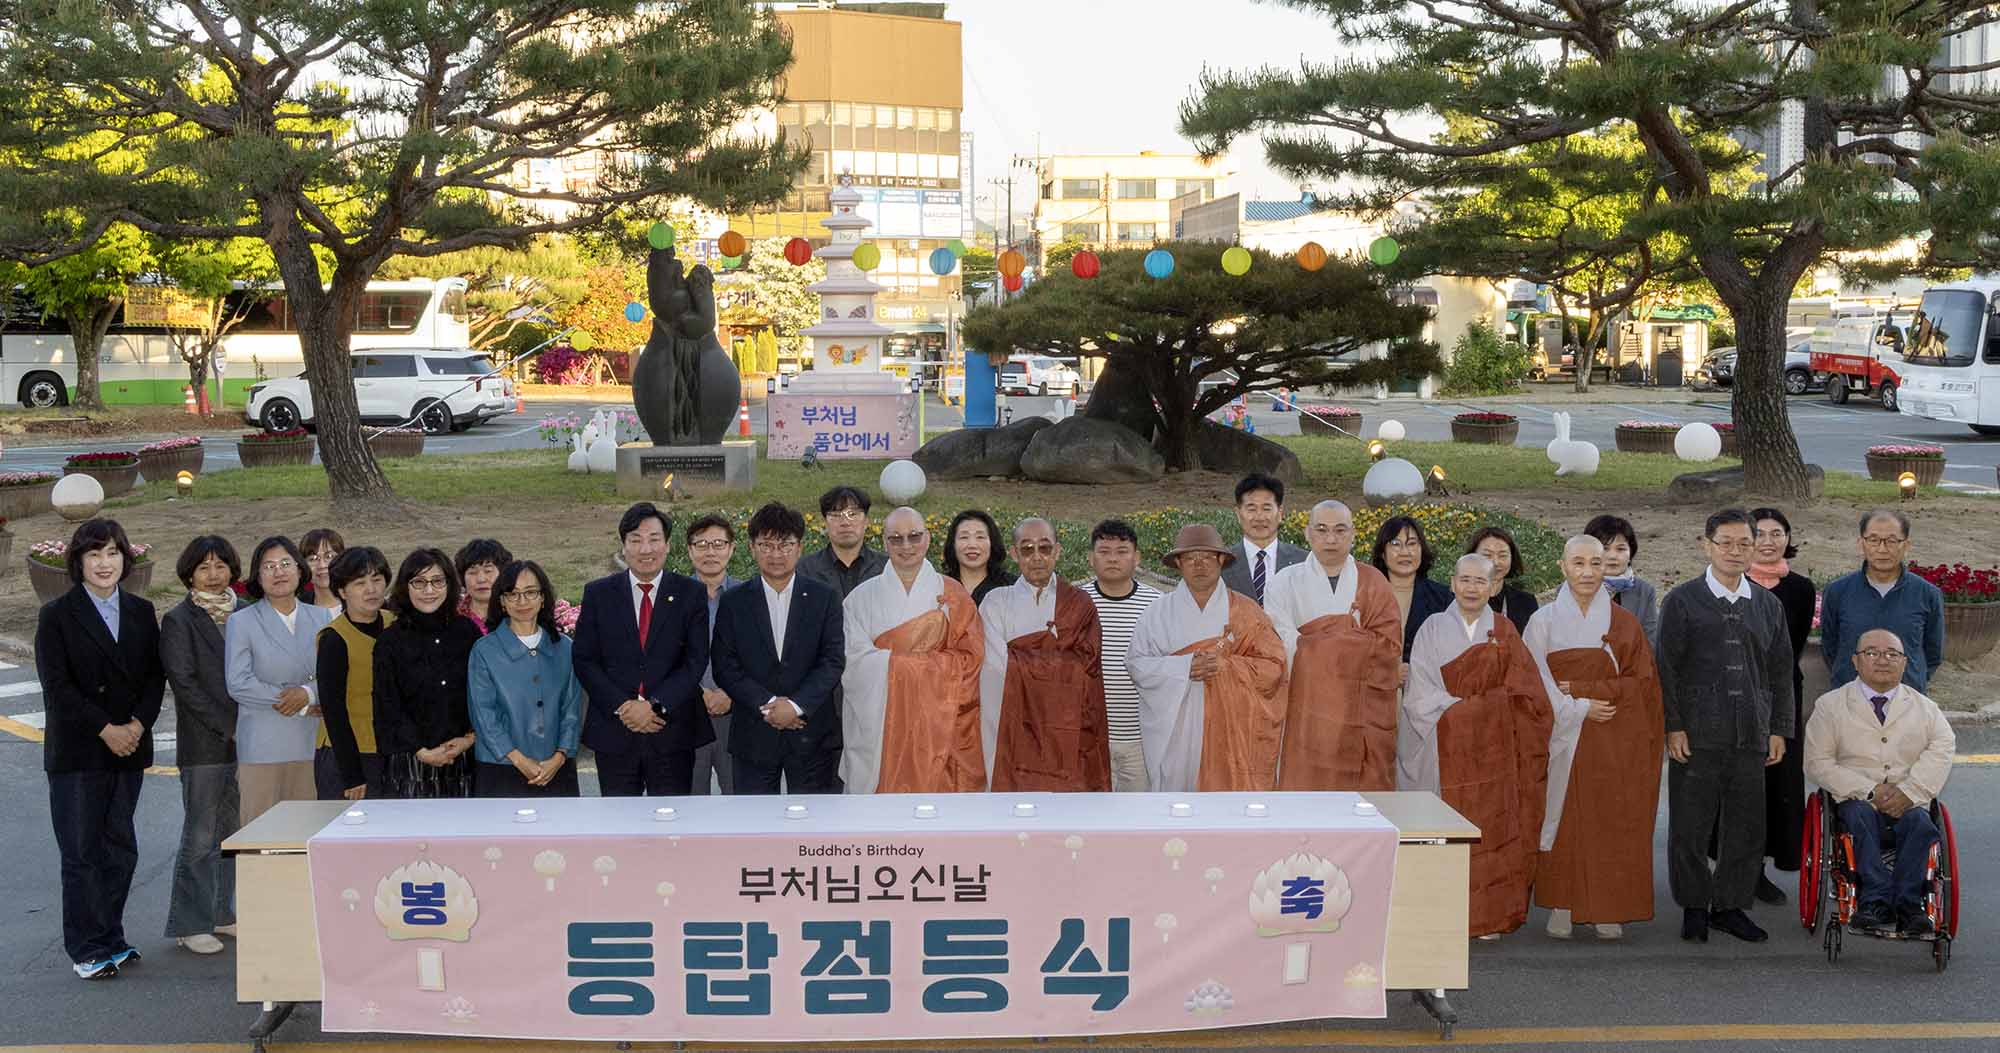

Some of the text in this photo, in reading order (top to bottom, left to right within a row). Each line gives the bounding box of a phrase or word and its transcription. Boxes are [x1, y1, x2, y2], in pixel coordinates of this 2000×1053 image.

[801, 406, 856, 426] 부처님
[813, 432, 890, 452] 품안에서
[799, 845, 924, 858] Buddha's Birthday
[401, 882, 447, 925] 봉
[1281, 876, 1325, 919] 축
[567, 917, 1130, 1016] 등탑점등식
